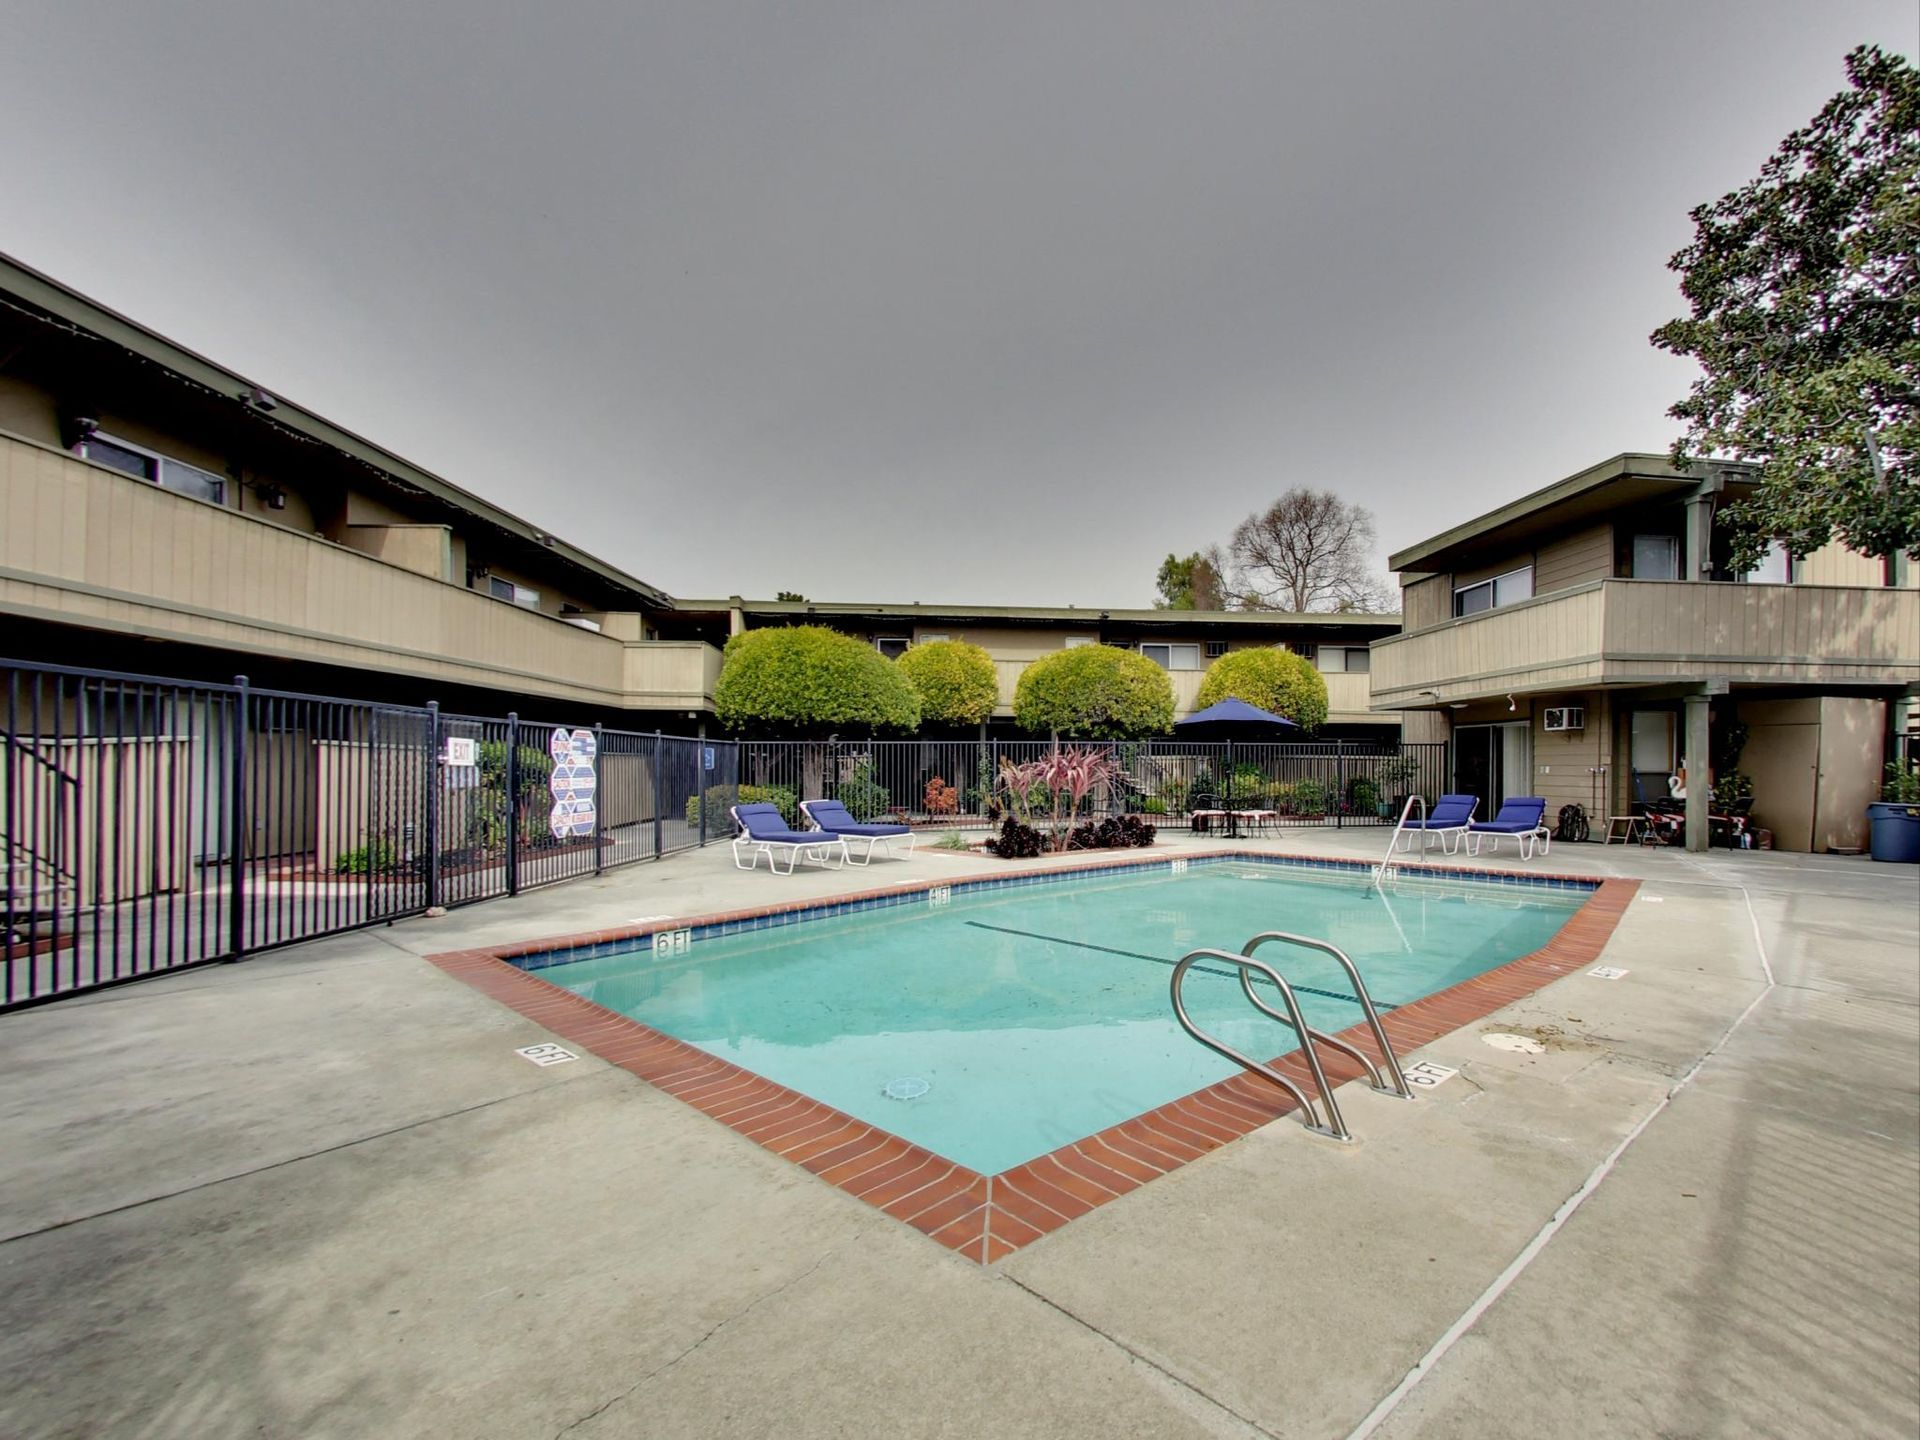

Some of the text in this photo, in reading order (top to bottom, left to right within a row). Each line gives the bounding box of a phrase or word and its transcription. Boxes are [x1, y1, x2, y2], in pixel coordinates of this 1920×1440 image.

[454, 742, 470, 760] EXIT
[657, 929, 689, 951] 6 FT
[523, 1045, 575, 1063] 6 FT
[1402, 1062, 1451, 1085] 6 FT
